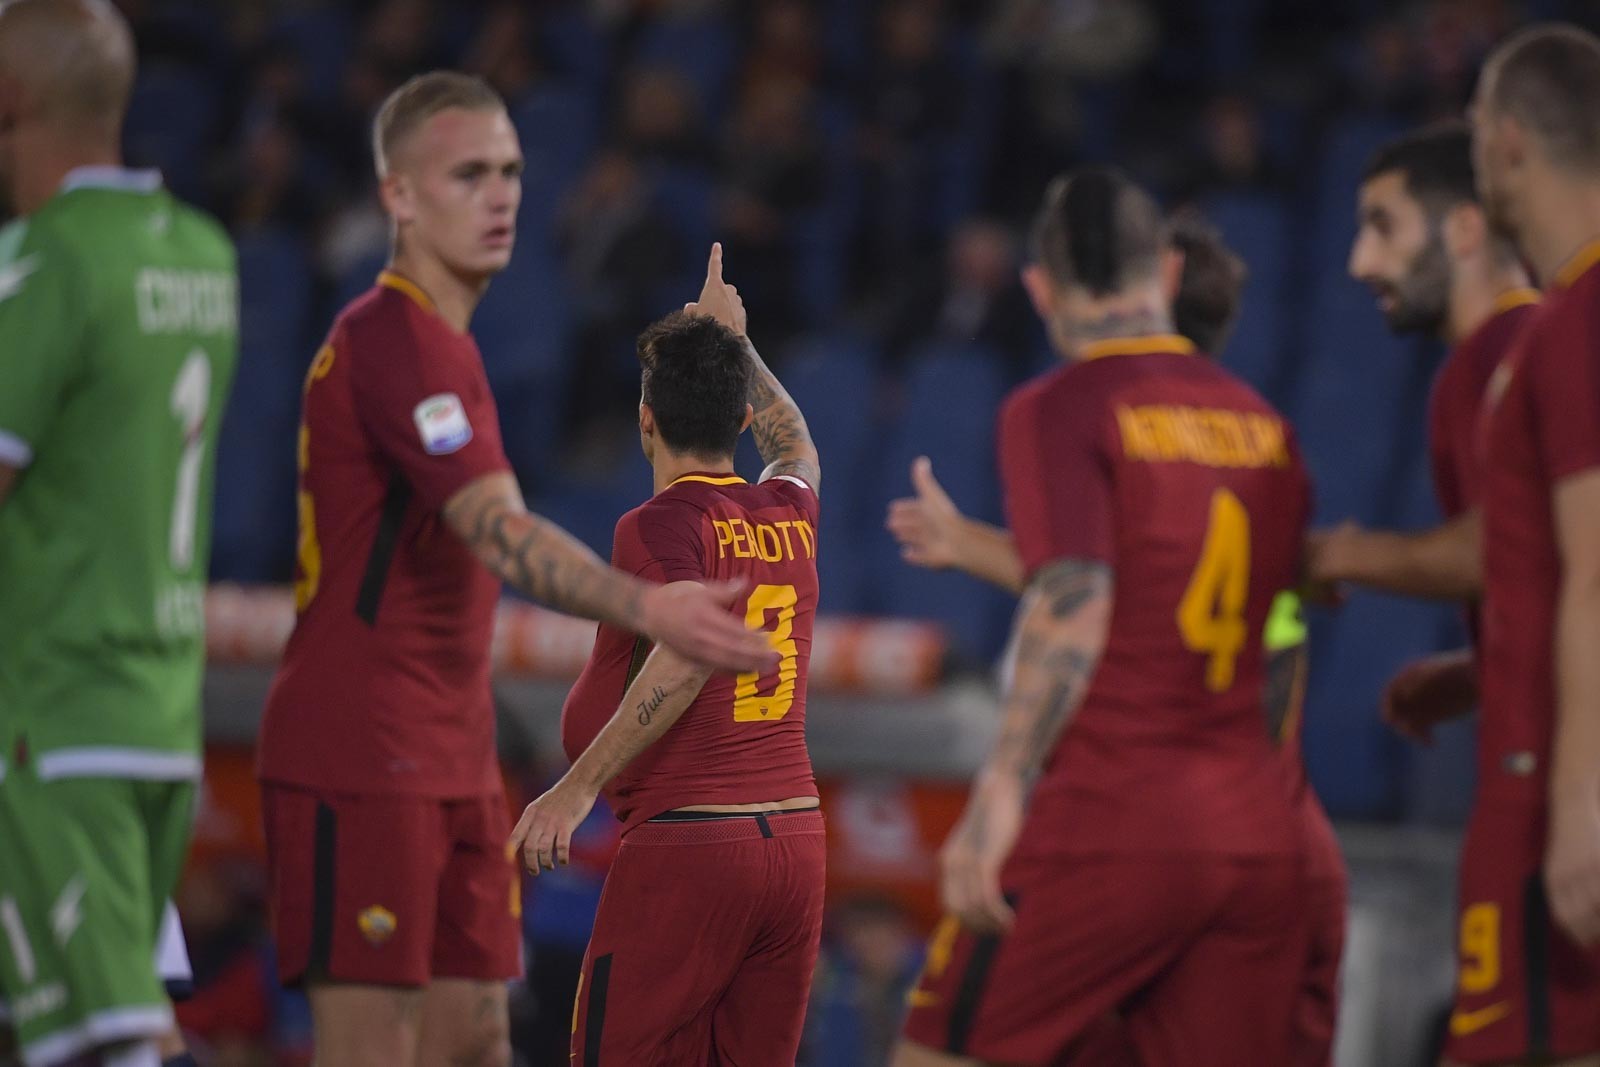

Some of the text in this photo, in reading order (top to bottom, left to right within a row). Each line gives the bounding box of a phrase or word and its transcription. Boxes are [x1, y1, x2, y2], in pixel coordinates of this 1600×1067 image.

[170, 347, 212, 573] 1
[733, 584, 798, 722] 8
[1177, 486, 1249, 692] 4
[637, 686, 668, 726] Juli
[1460, 902, 1500, 992] 9
